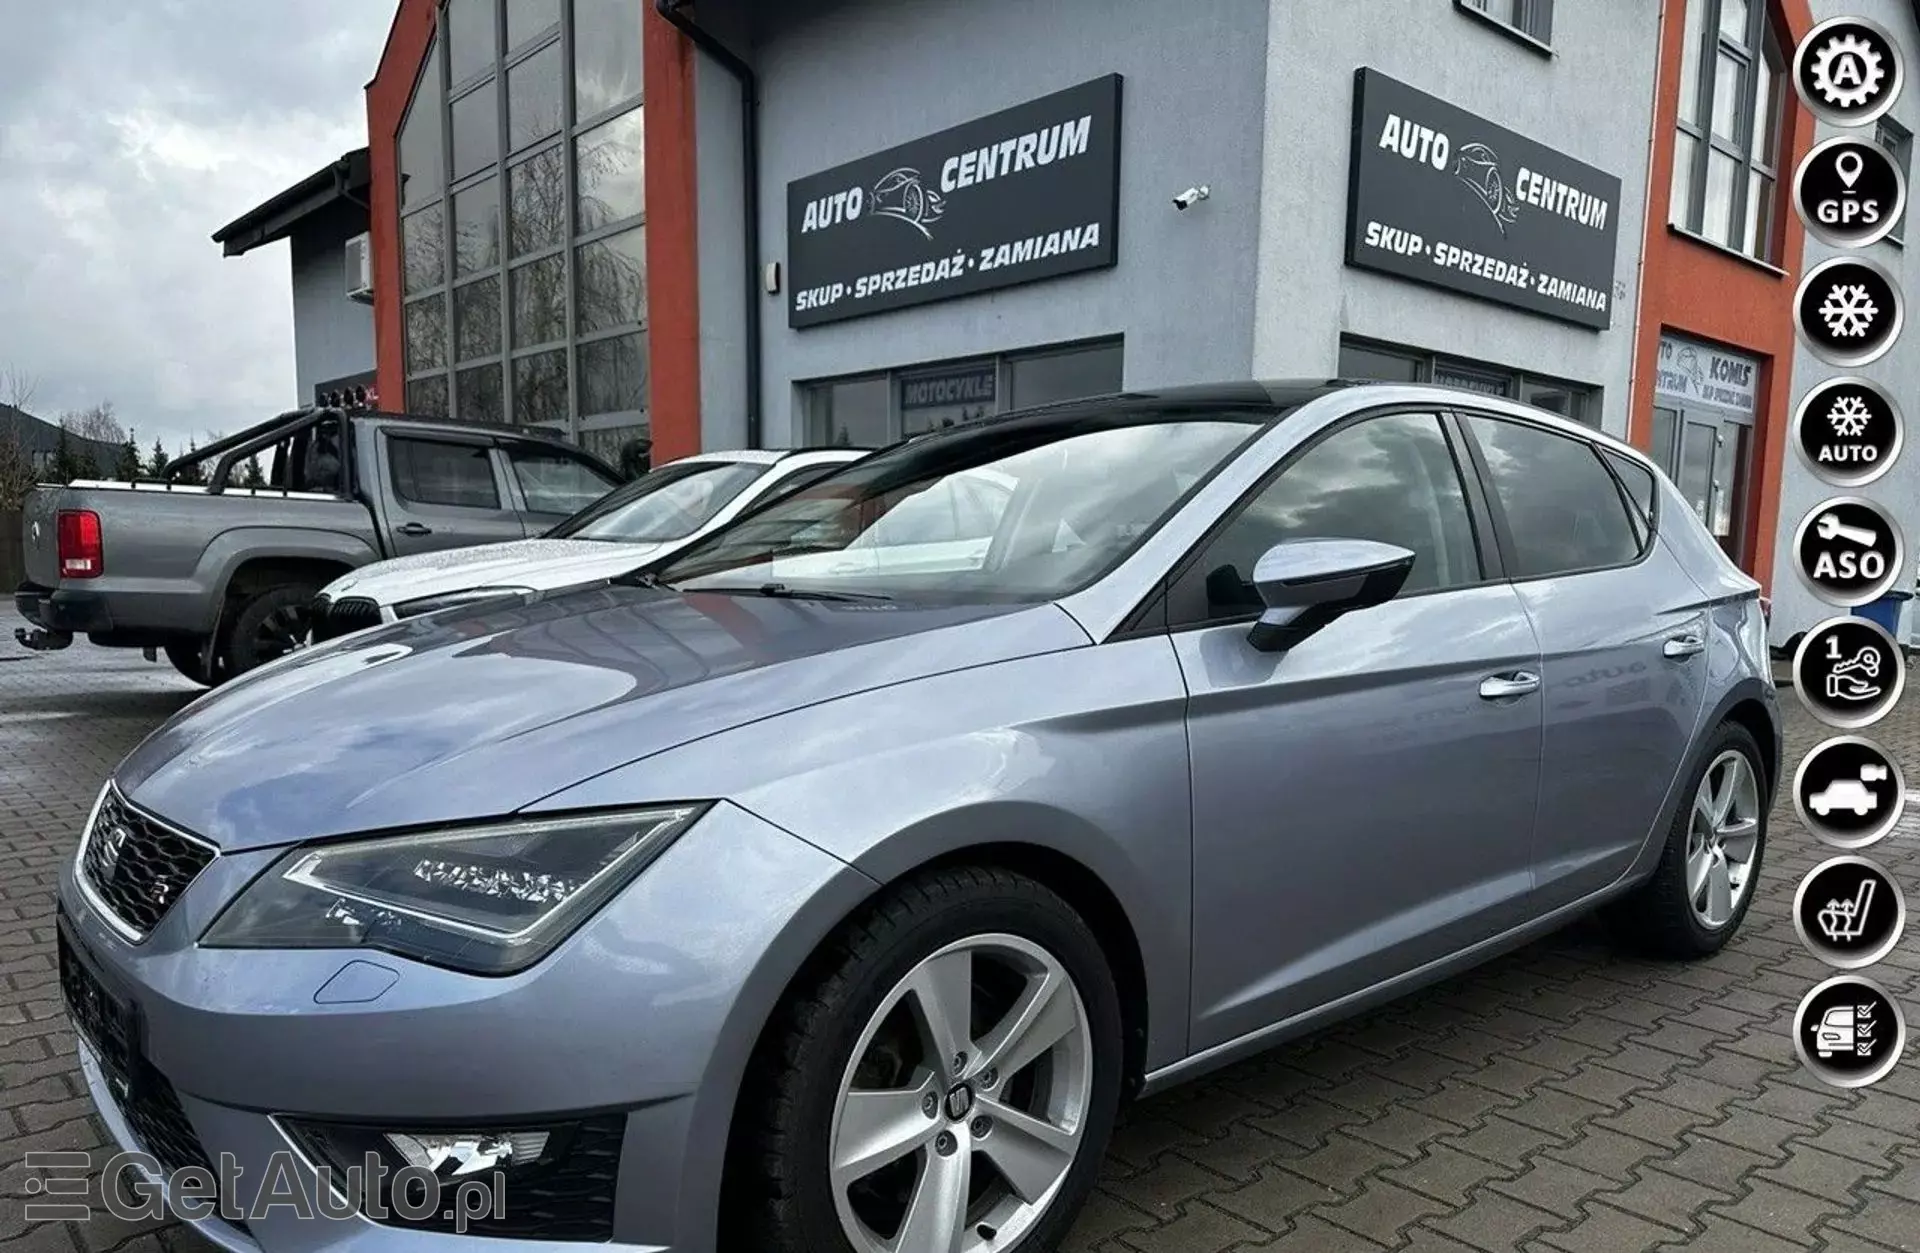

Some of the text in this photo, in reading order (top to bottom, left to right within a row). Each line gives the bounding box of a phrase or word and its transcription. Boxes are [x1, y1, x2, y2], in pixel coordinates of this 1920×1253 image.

[801, 115, 1092, 234] AUTO CENTRUM
[1379, 113, 1608, 230] AUTO CENTRUM
[795, 223, 1100, 312] SKUP SPRZEDAŻ ZAMIANA
[1364, 221, 1607, 312] SKUP SPRZEDAŻ ZAMIANA
[905, 373, 994, 404] MOTOCYKLE
[1709, 355, 1752, 387] KOMIS
